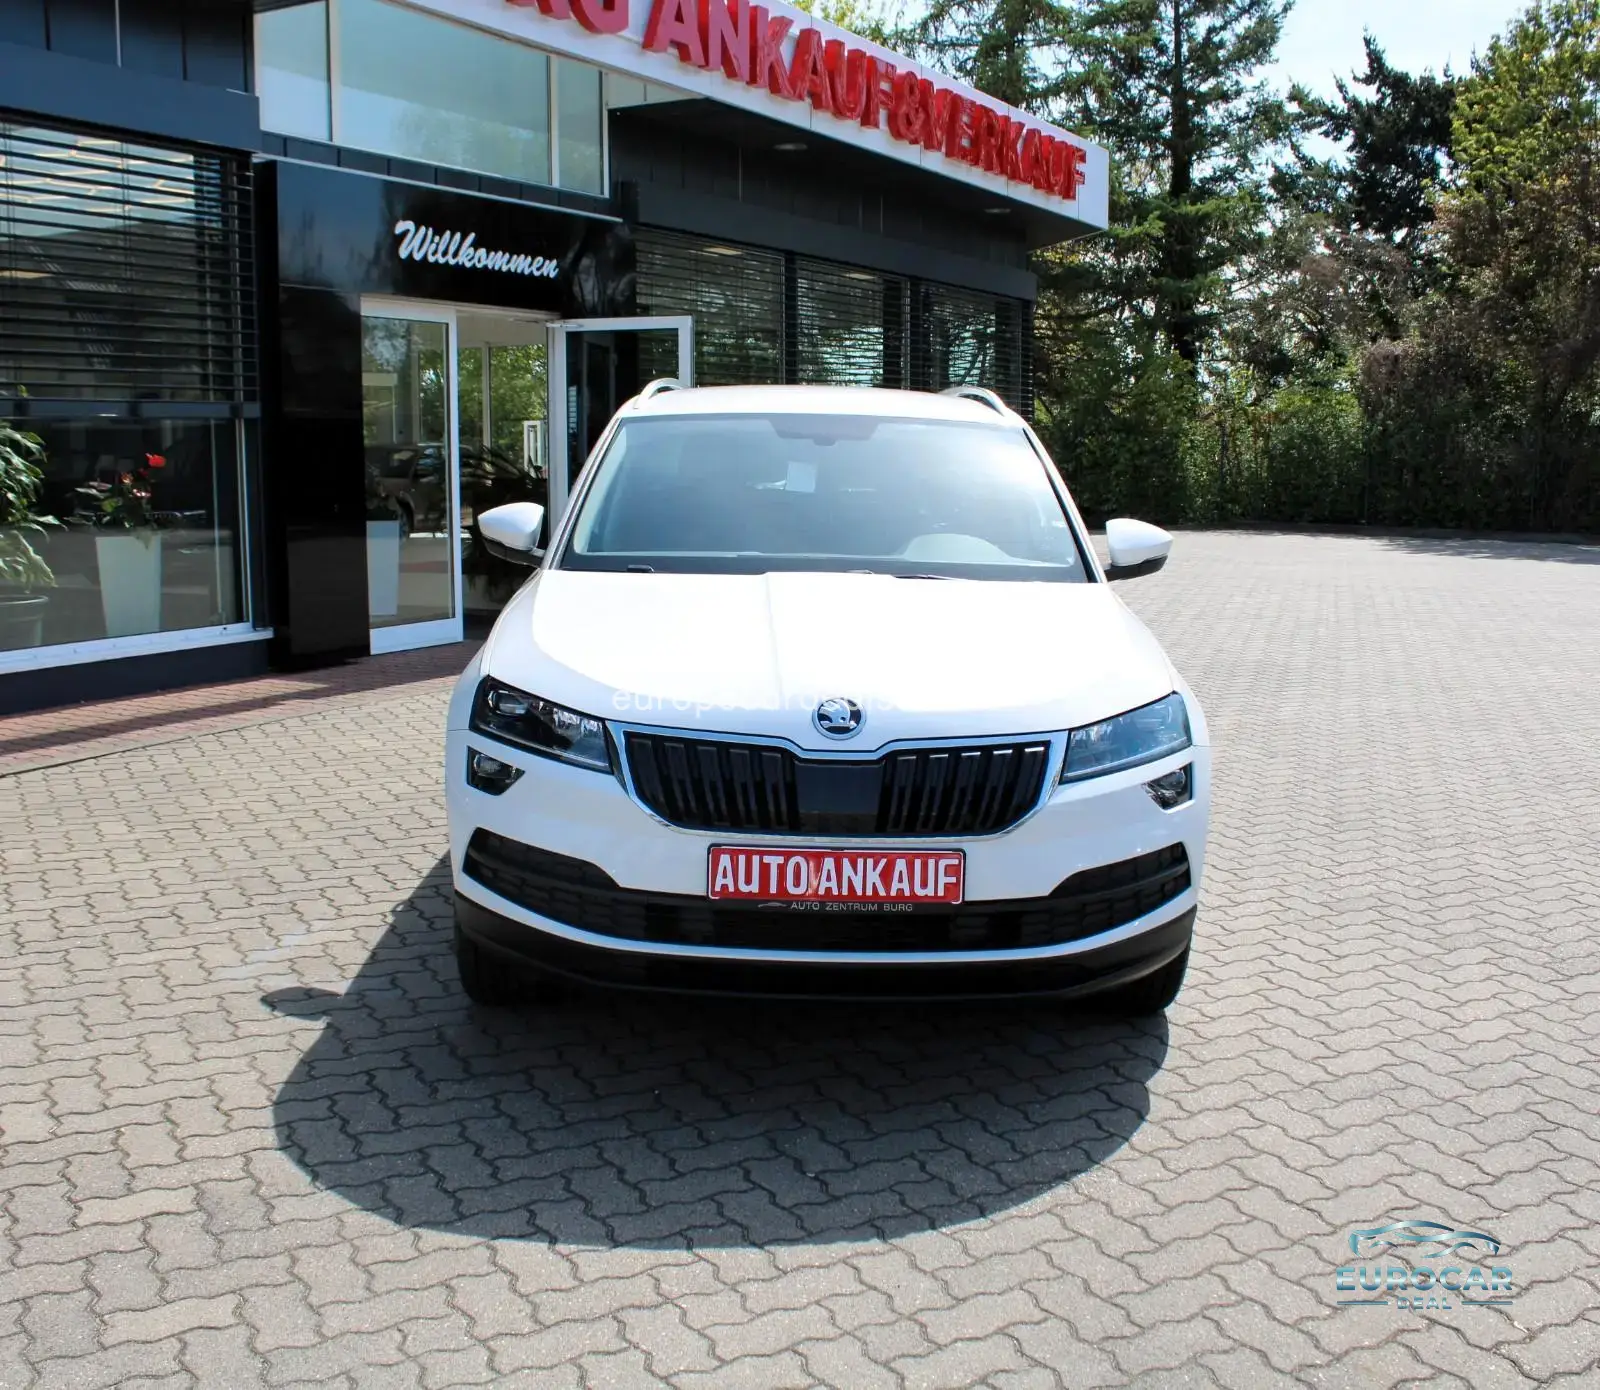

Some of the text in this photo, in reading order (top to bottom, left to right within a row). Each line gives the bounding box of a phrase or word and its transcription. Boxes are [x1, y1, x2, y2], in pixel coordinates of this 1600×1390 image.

[394, 219, 559, 278] Willkommen
[713, 853, 960, 898] AUTO ANKAUF
[790, 901, 913, 912] AUTO ZENTRUM BURG
